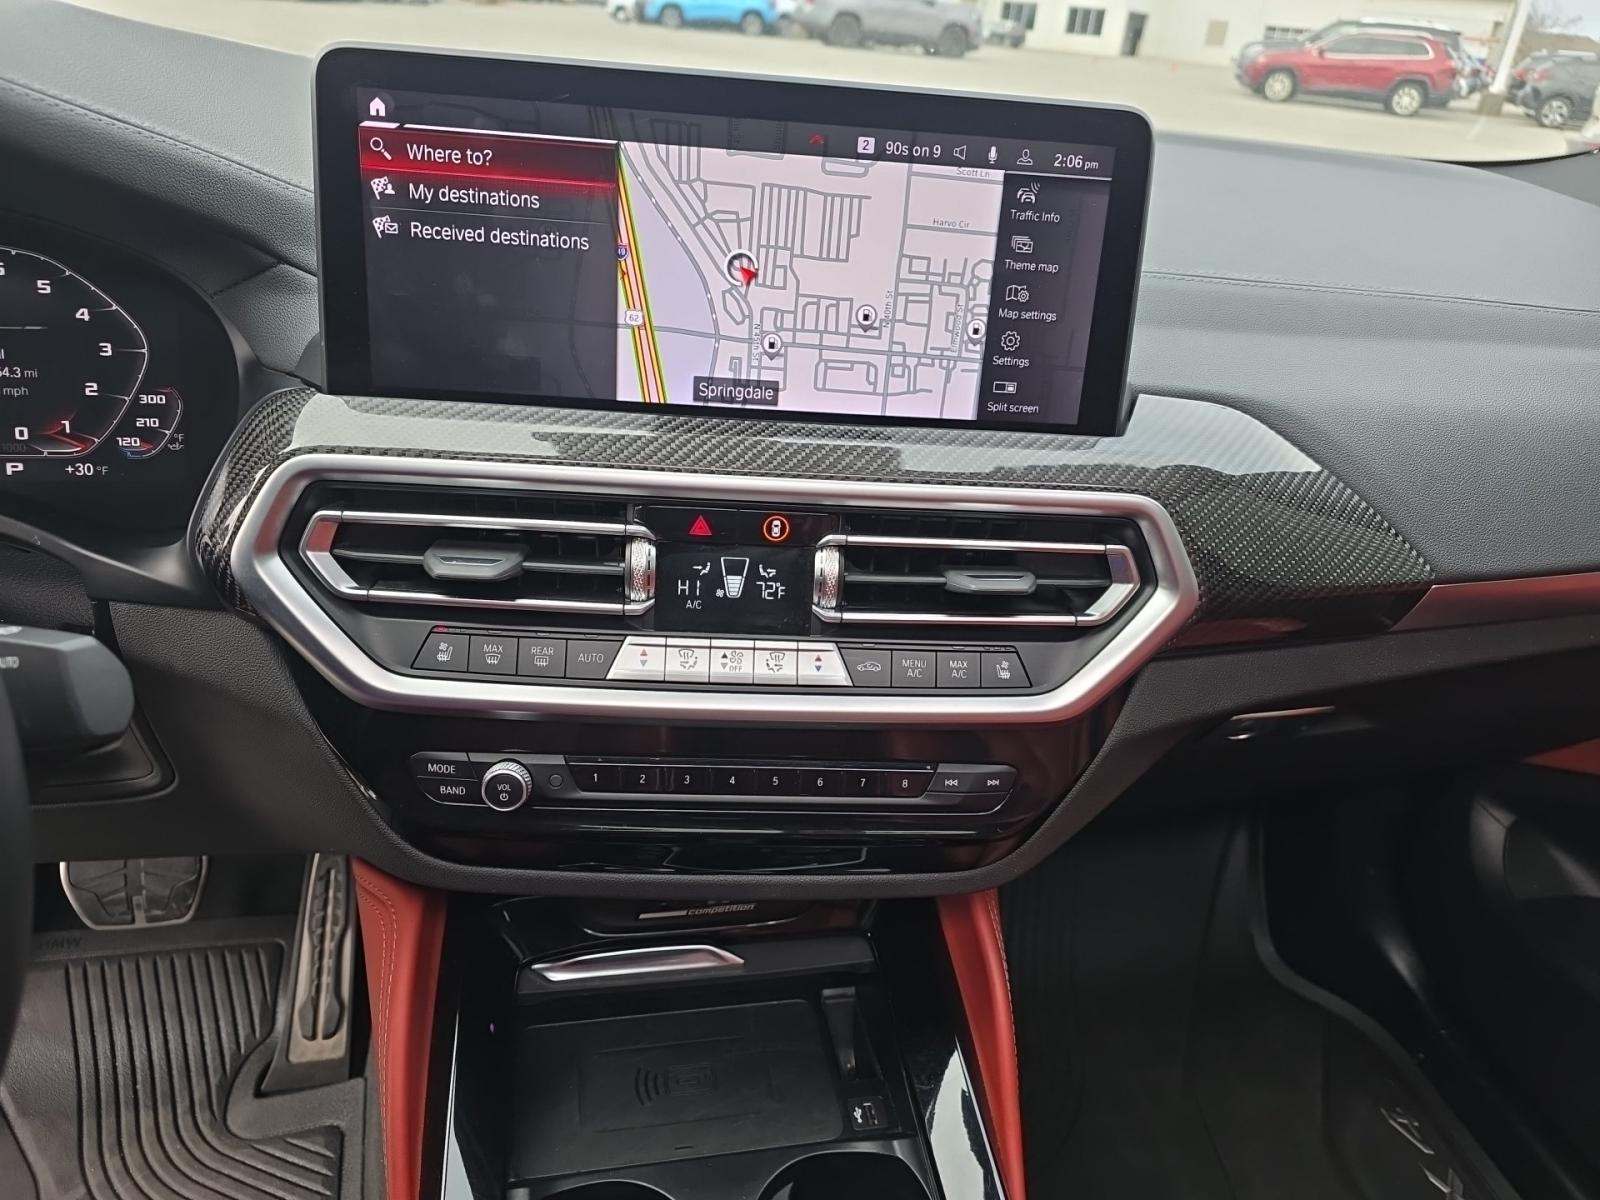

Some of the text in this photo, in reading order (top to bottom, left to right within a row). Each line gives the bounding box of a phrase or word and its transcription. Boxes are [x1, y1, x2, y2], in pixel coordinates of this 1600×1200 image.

[862, 140, 870, 150] 2
[885, 141, 941, 158] 90s on 9
[406, 143, 494, 166] Where to?
[1053, 153, 1099, 170] 2:06 pm
[408, 183, 541, 209] My destinations
[1010, 209, 1060, 223] Traffic Info
[410, 221, 590, 251] Received destinations
[1004, 259, 1060, 274] Theme map
[36, 280, 51, 294] 5
[75, 307, 90, 322] 4
[628, 313, 639, 322] 62
[998, 308, 1057, 322] Map settings
[99, 342, 113, 356] 3
[992, 355, 1030, 368] Settings
[24, 369, 38, 378] mi
[3, 386, 29, 398] mph
[85, 382, 99, 396] 2
[699, 382, 774, 401] Springdale
[138, 394, 166, 404] 300
[987, 401, 1039, 414] Split screen
[61, 420, 70, 433] 1
[135, 417, 160, 428] 210
[14, 426, 29, 440] 0
[116, 437, 141, 447] 120
[5, 462, 24, 476] P
[65, 463, 94, 476] +30
[685, 600, 702, 609] A/C
[483, 644, 504, 653] MAX
[531, 647, 554, 655] REAR
[0, 656, 20, 668] UTO
[577, 653, 604, 663] AUTO
[902, 659, 927, 668] MENU
[950, 660, 968, 668] MAX
[728, 665, 744, 673] OFF
[907, 669, 923, 678] A/C
[951, 669, 967, 679] A/C
[427, 763, 456, 774] MODE
[593, 773, 598, 782] 1
[639, 774, 646, 784] 2
[683, 775, 690, 785] 3
[728, 775, 736, 785] 4
[772, 775, 779, 785] 5
[816, 777, 823, 786] 6
[860, 778, 866, 786] 7
[901, 779, 908, 788] 8
[440, 786, 466, 796] BAND
